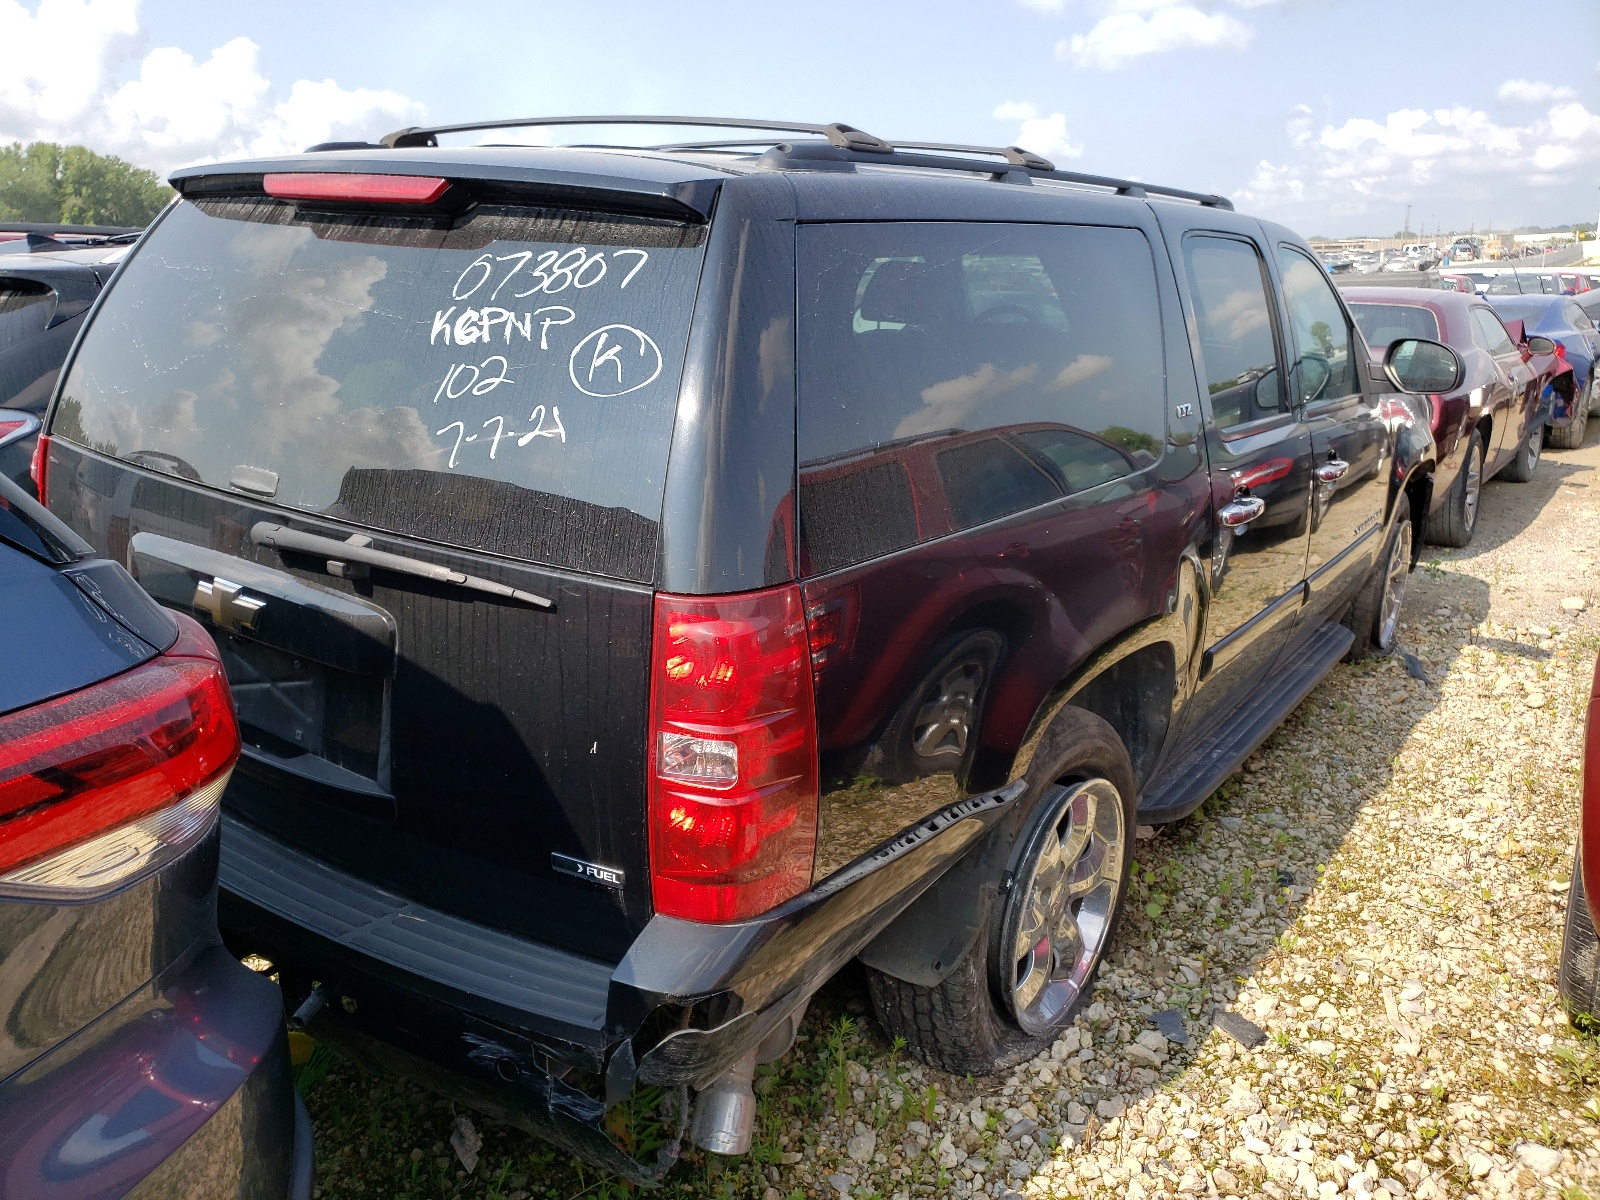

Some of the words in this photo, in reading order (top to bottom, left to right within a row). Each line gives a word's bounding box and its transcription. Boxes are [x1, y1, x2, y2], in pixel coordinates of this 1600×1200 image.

[453, 247, 648, 300] 073807
[434, 356, 515, 403] 102
[589, 333, 622, 382] K
